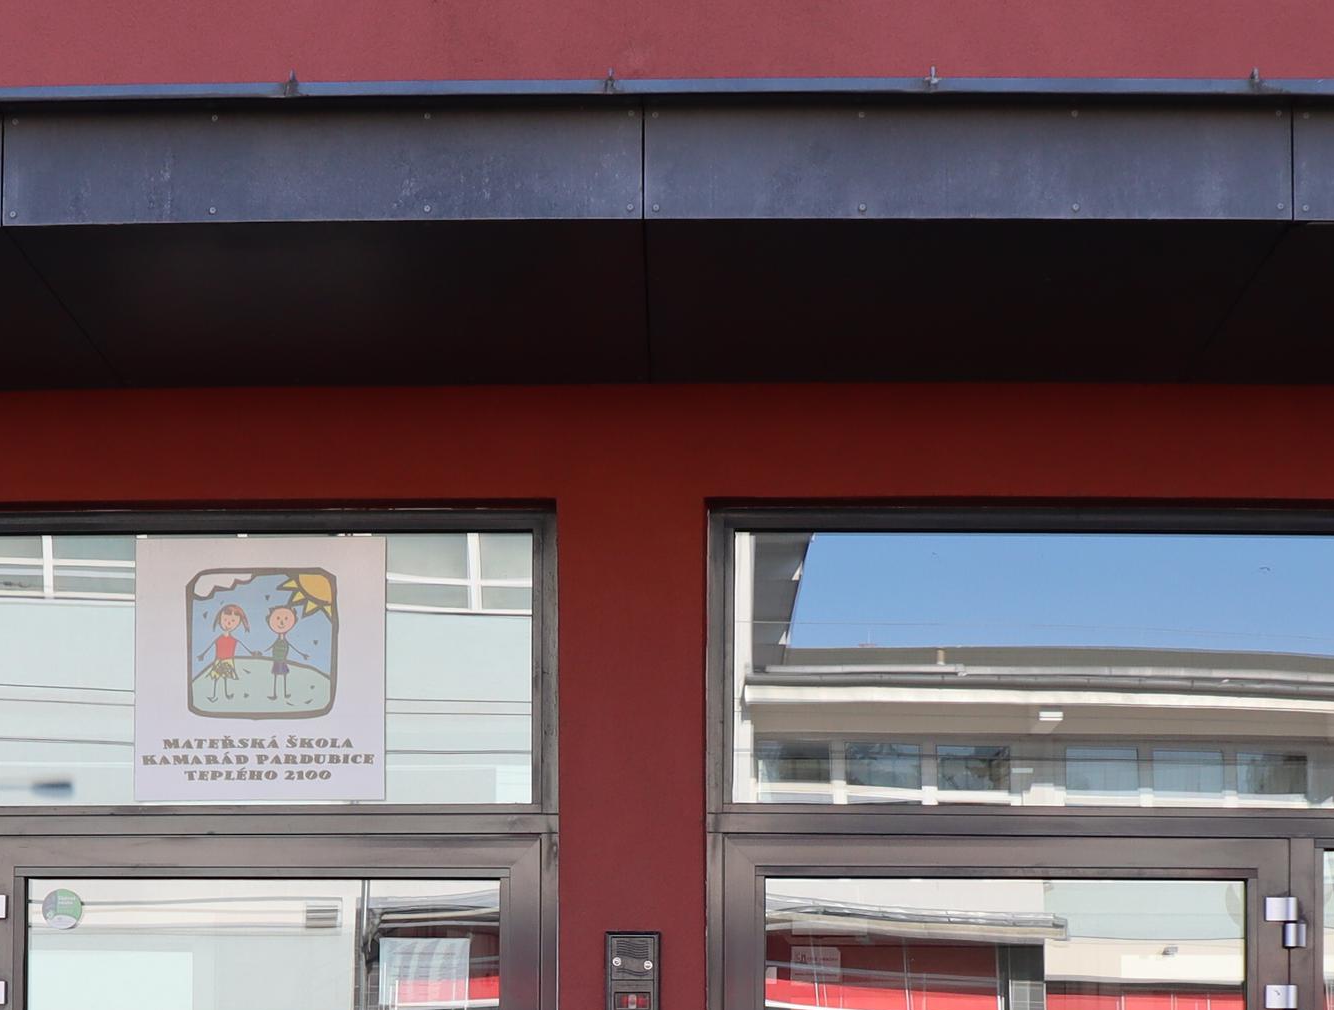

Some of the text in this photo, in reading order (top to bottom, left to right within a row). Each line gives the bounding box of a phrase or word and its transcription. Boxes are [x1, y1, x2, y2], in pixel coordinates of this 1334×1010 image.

[162, 735, 354, 750] MATEŘSKÁ ŠKOLA
[142, 752, 375, 766] KAMARÁD PARDUBICE
[183, 767, 332, 781] TEPLÉHO 2100
